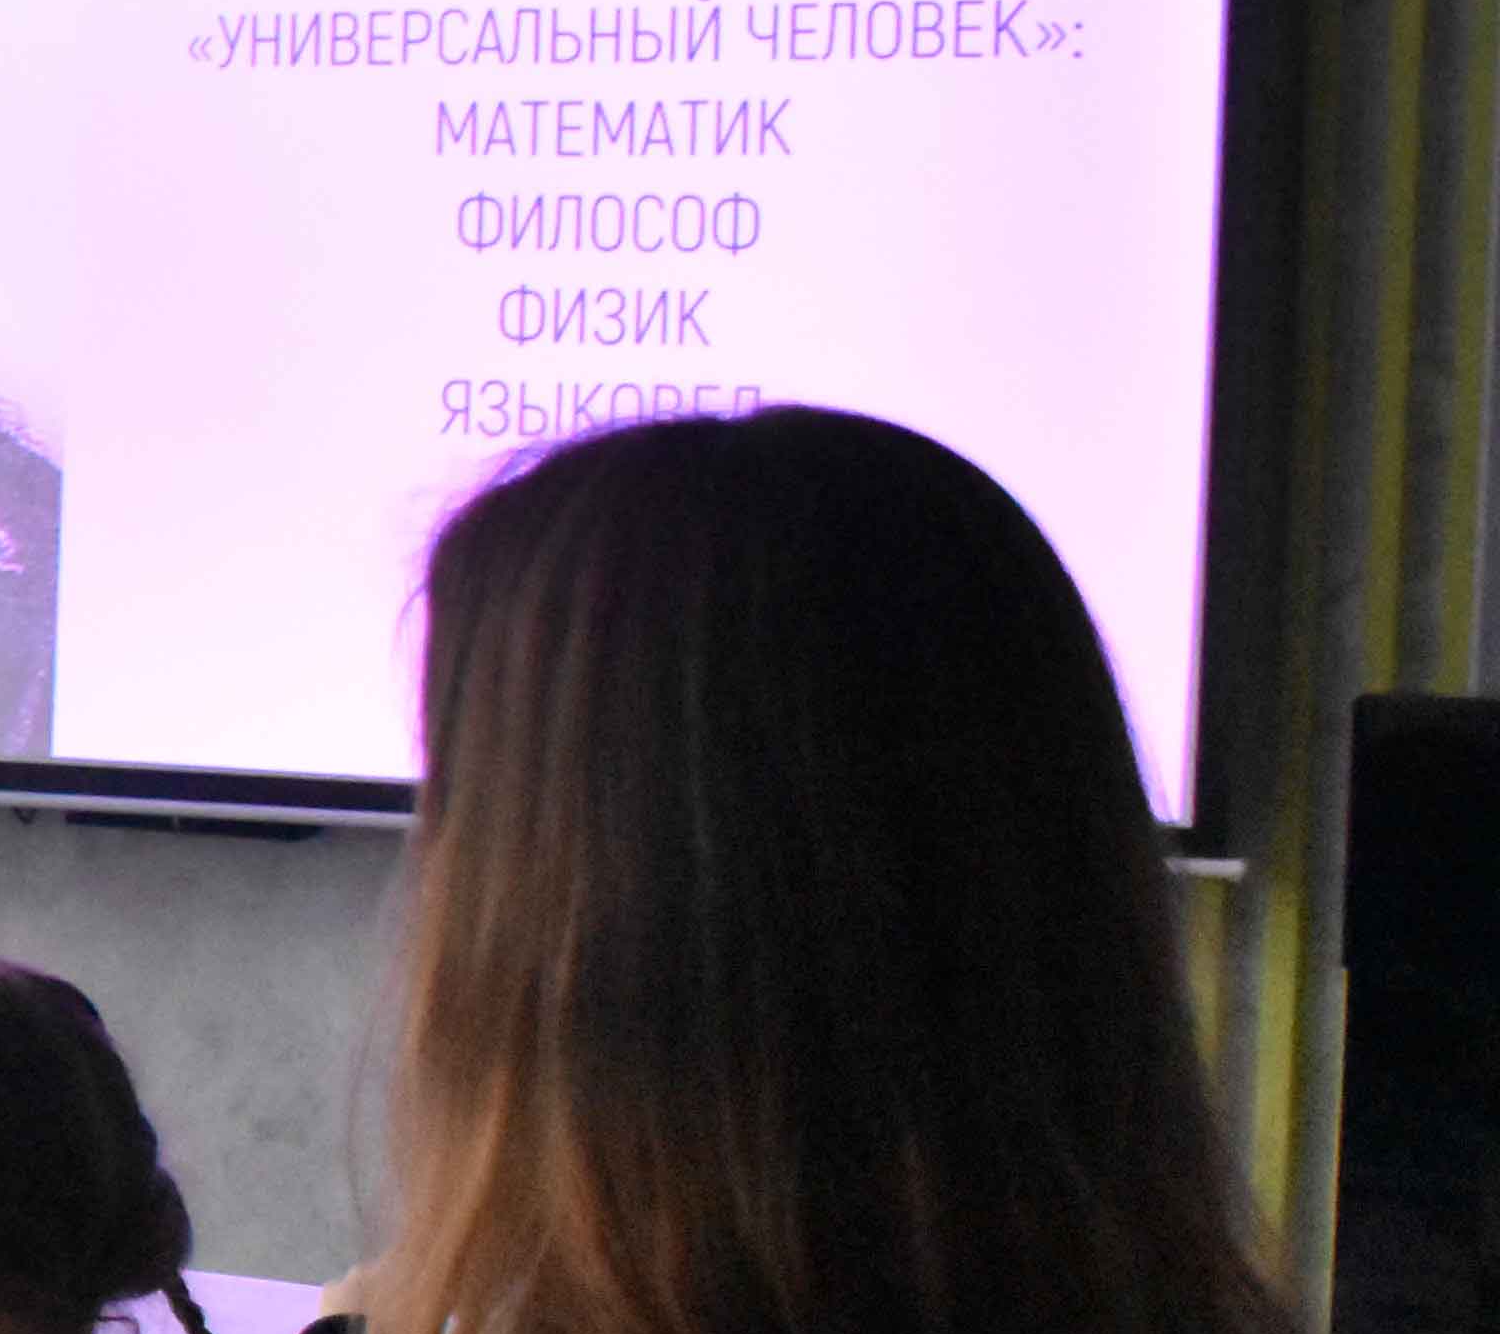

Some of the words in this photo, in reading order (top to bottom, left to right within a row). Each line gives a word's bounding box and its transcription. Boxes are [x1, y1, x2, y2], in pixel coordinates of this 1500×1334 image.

[435, 98, 793, 159] МАТЕМАТИК
[456, 189, 762, 258] ФИЛОСОФ
[497, 282, 712, 348] ФИЗИК
